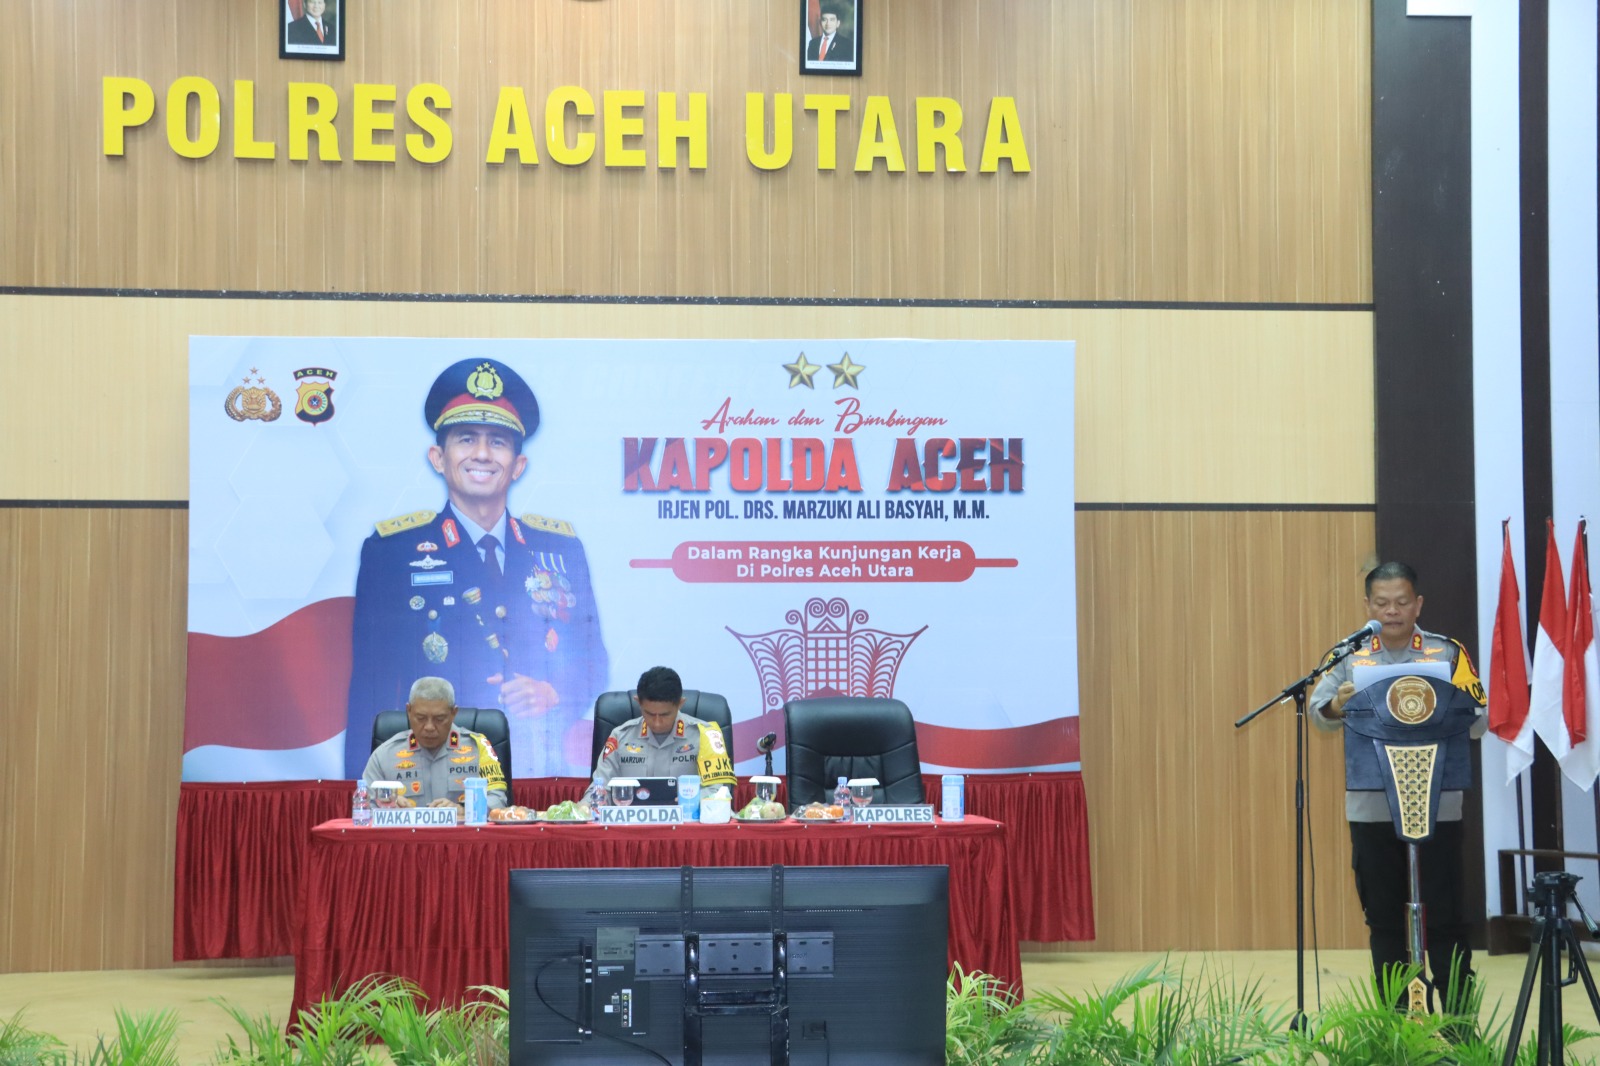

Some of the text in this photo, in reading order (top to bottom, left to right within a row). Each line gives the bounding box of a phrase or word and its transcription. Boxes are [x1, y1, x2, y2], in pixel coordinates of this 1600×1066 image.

[103, 76, 1032, 173] POLRES ACEH UTARA
[297, 369, 334, 378] ACEH
[700, 396, 948, 436] Arahan dan Bimbingan
[621, 437, 1026, 493] KAPOLDA ACEH
[658, 500, 990, 522] IRJEN POL. DRS. MARZUKI ALI BASYAH, M.M.
[688, 545, 961, 563] Dalam Rangka Kunjungan Kerja
[737, 563, 914, 578] Di Polres Aceh Utara
[621, 756, 646, 764] MARZUKI
[449, 765, 478, 774] POLRI
[376, 810, 454, 824] WAKA POLDA
[603, 808, 679, 823] KAPOLDA
[854, 808, 932, 822] KAPOLRES
